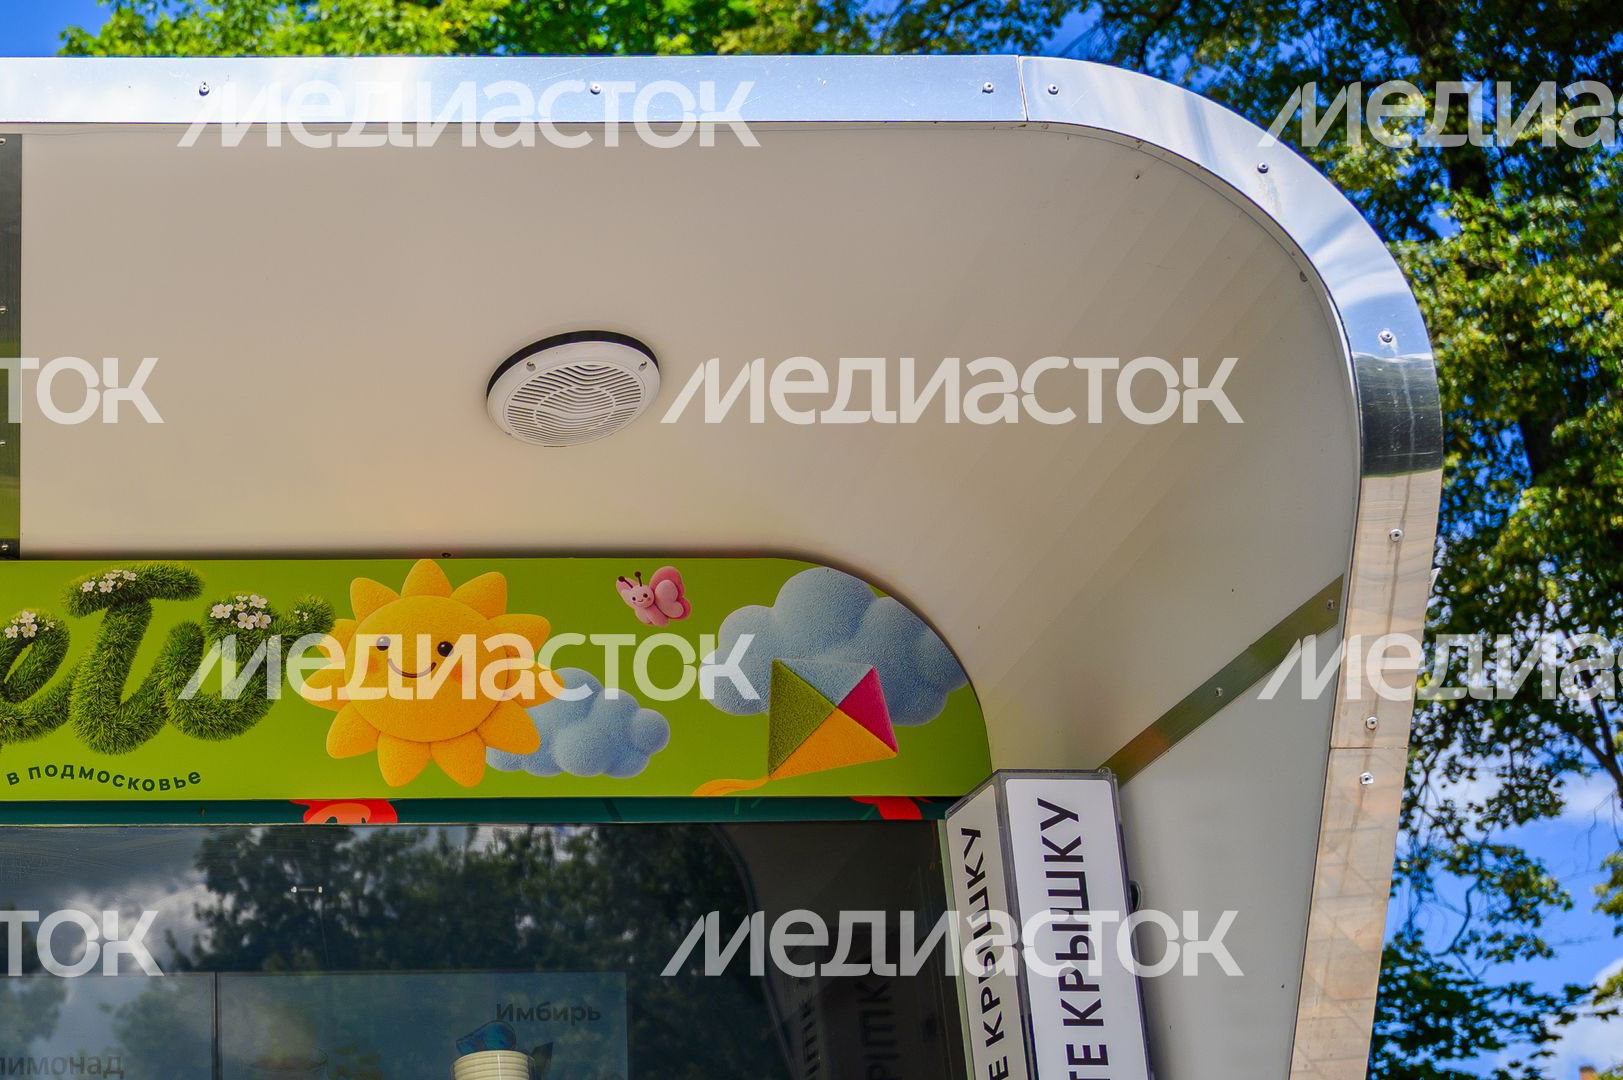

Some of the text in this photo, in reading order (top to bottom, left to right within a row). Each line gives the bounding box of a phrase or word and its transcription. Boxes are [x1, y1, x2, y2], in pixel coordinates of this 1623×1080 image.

[6, 768, 20, 787] в
[960, 826, 1007, 1048] КРЫШКУ
[1037, 797, 1104, 1028] КРЫШКУ
[495, 1002, 602, 1026] Имбирь
